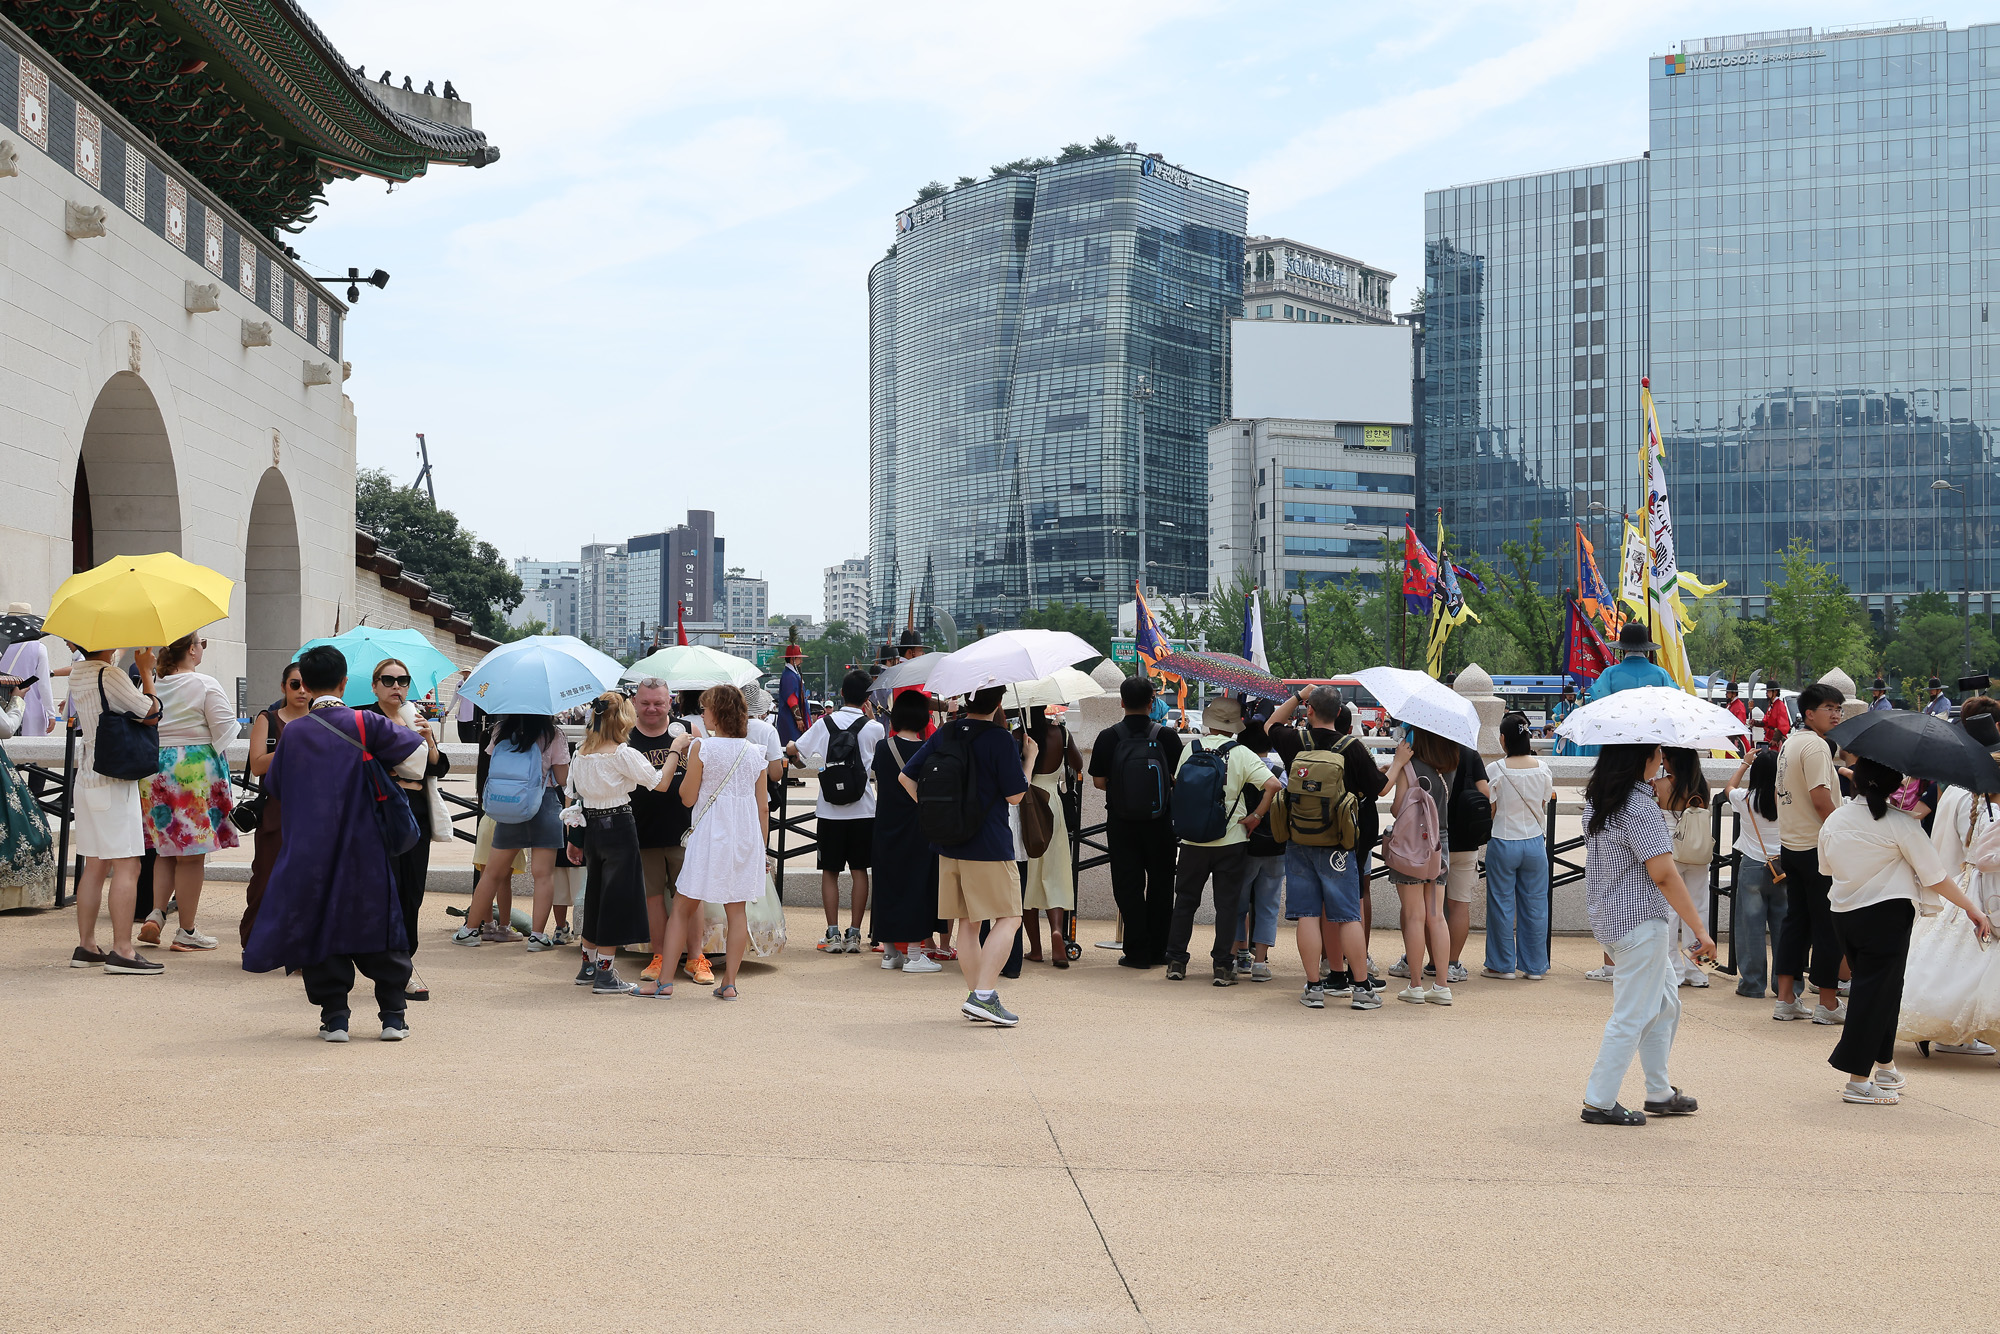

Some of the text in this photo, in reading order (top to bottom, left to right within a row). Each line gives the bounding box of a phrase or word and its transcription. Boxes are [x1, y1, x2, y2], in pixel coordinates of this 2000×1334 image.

[1689, 50, 1759, 69] Microsoft
[1285, 255, 1347, 288] SOMERSET
[685, 563, 695, 616] 안국빌딩
